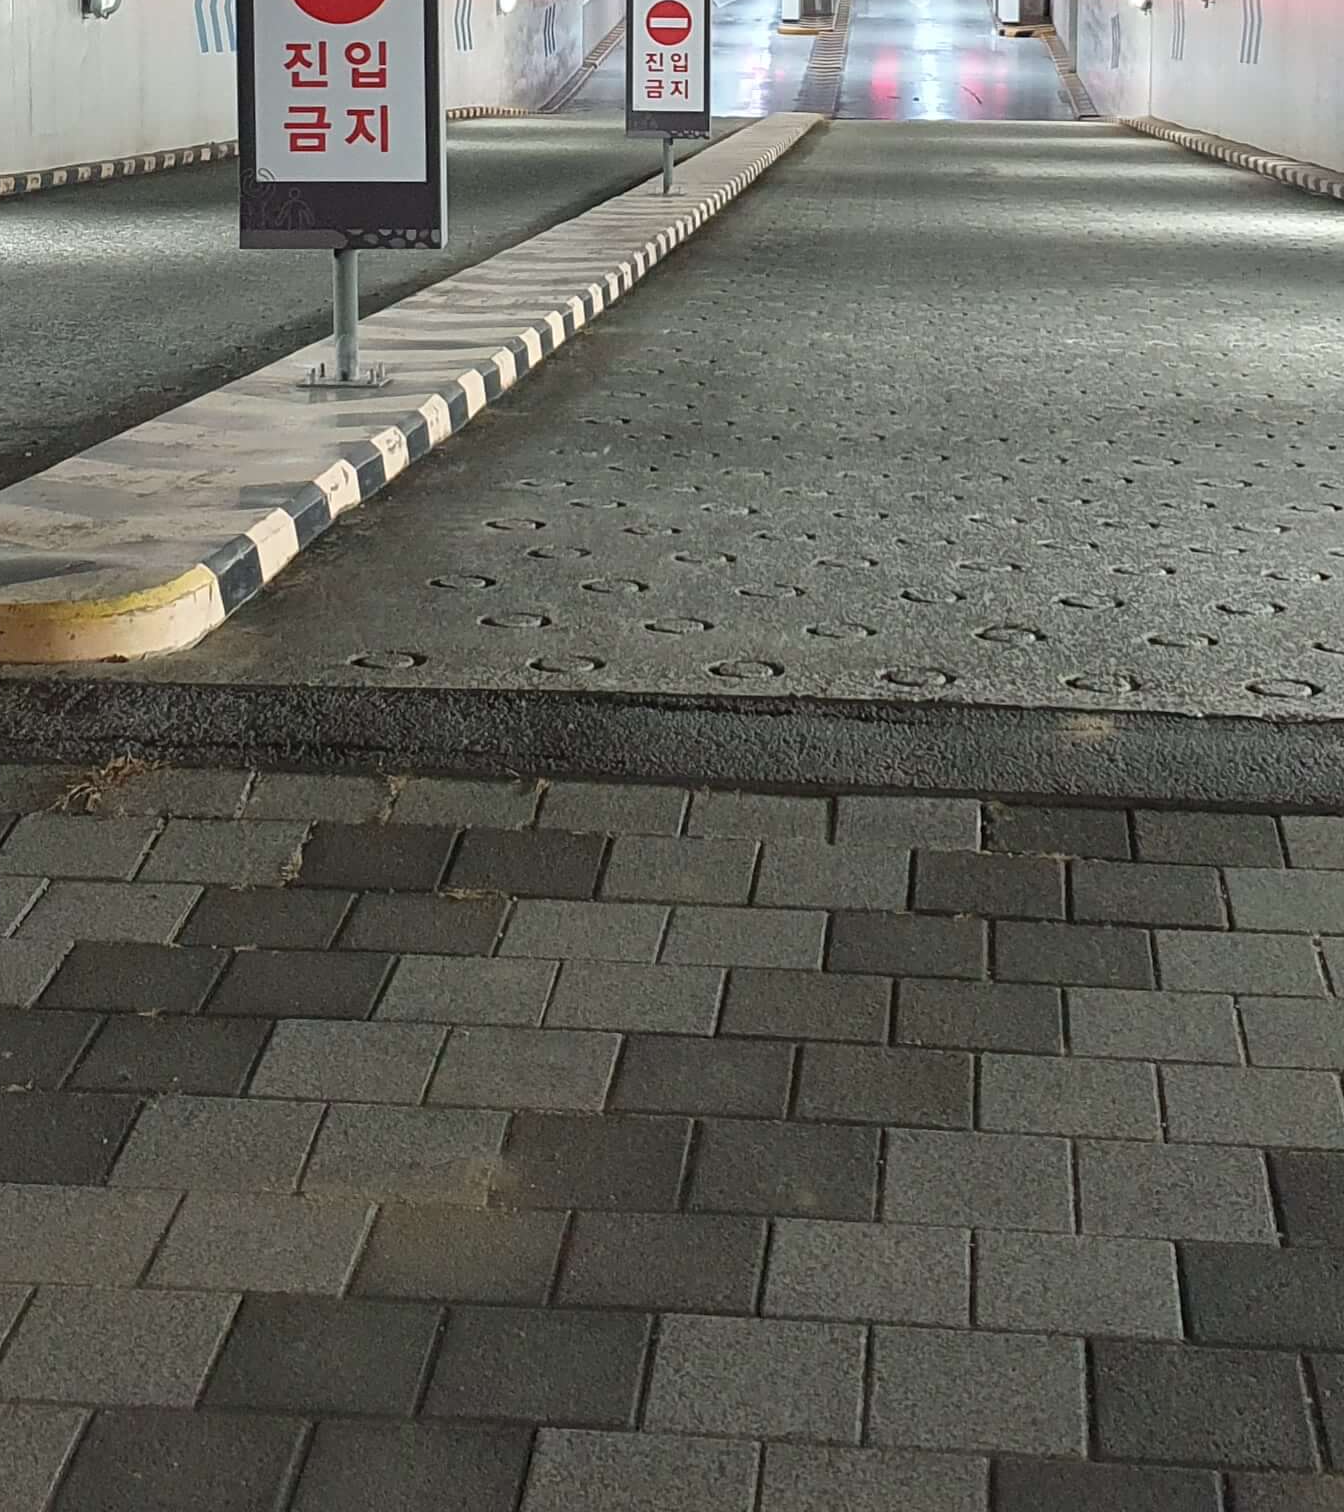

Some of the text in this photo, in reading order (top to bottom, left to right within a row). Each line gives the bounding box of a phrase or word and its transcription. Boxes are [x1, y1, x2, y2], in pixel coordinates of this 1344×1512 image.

[283, 40, 388, 89] 진입
[645, 52, 689, 73] 진입
[645, 79, 689, 100] 금지
[283, 104, 389, 153] 금지
